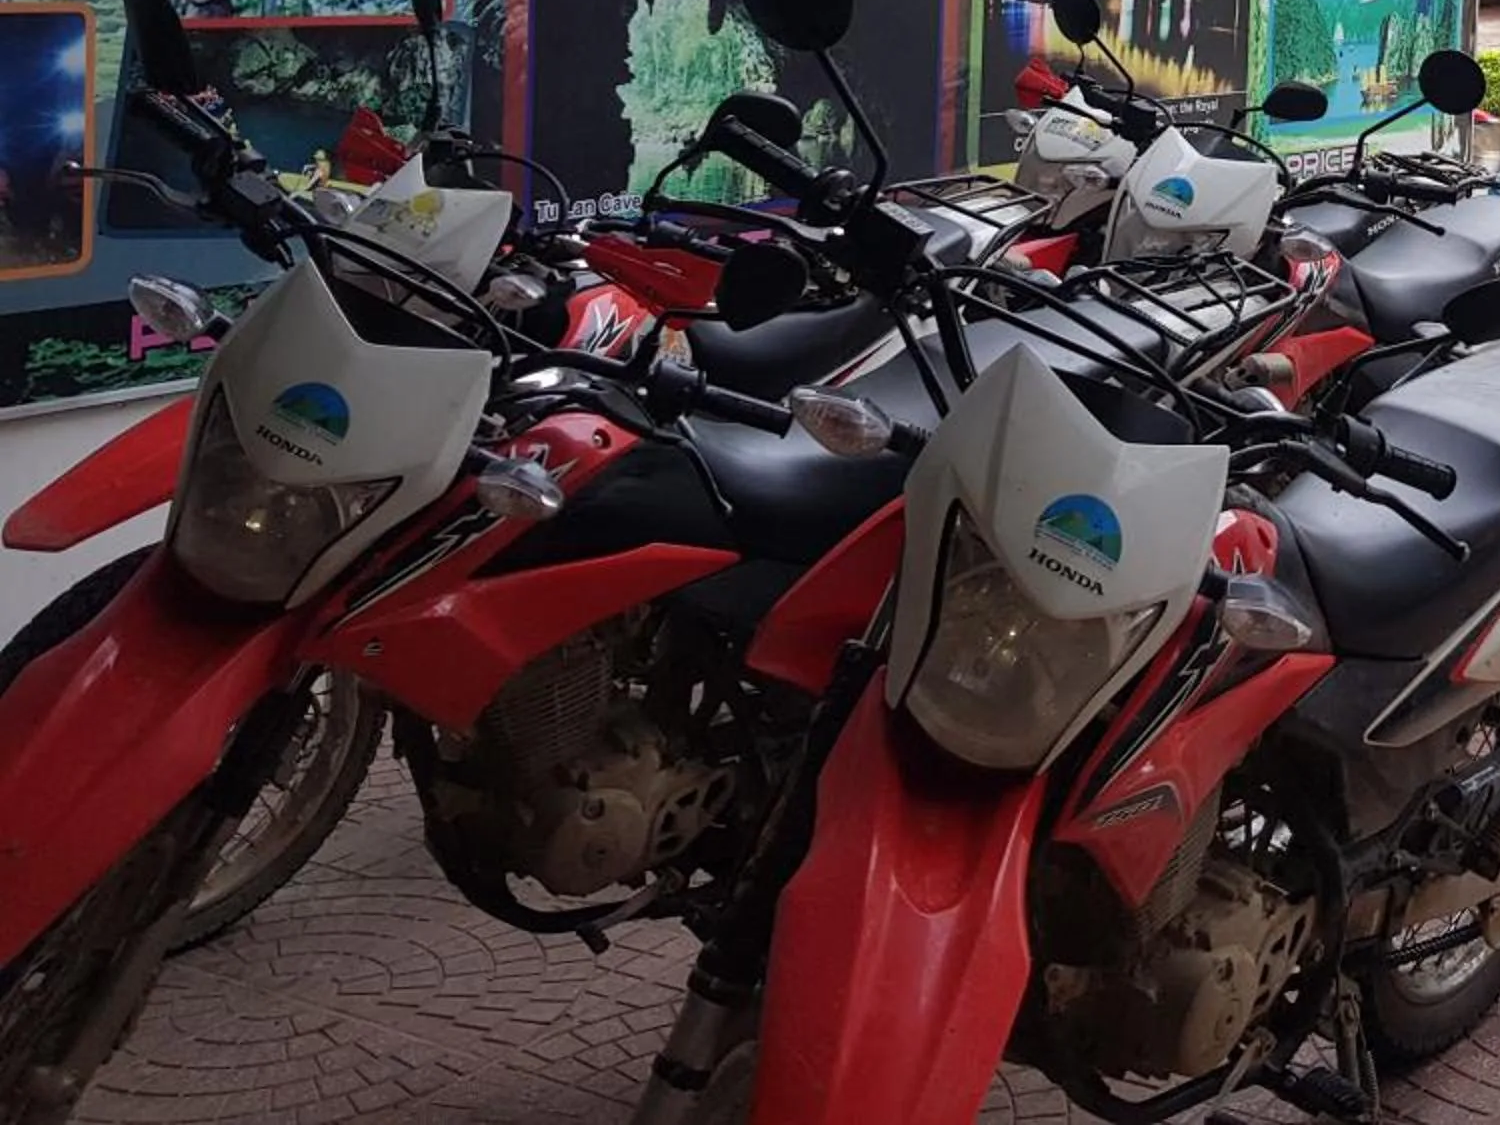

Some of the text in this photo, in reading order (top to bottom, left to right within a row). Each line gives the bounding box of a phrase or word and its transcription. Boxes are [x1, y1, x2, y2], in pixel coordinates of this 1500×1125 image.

[534, 200, 559, 223] Tu
[568, 198, 597, 220] an
[1028, 547, 1104, 596] HONDA
